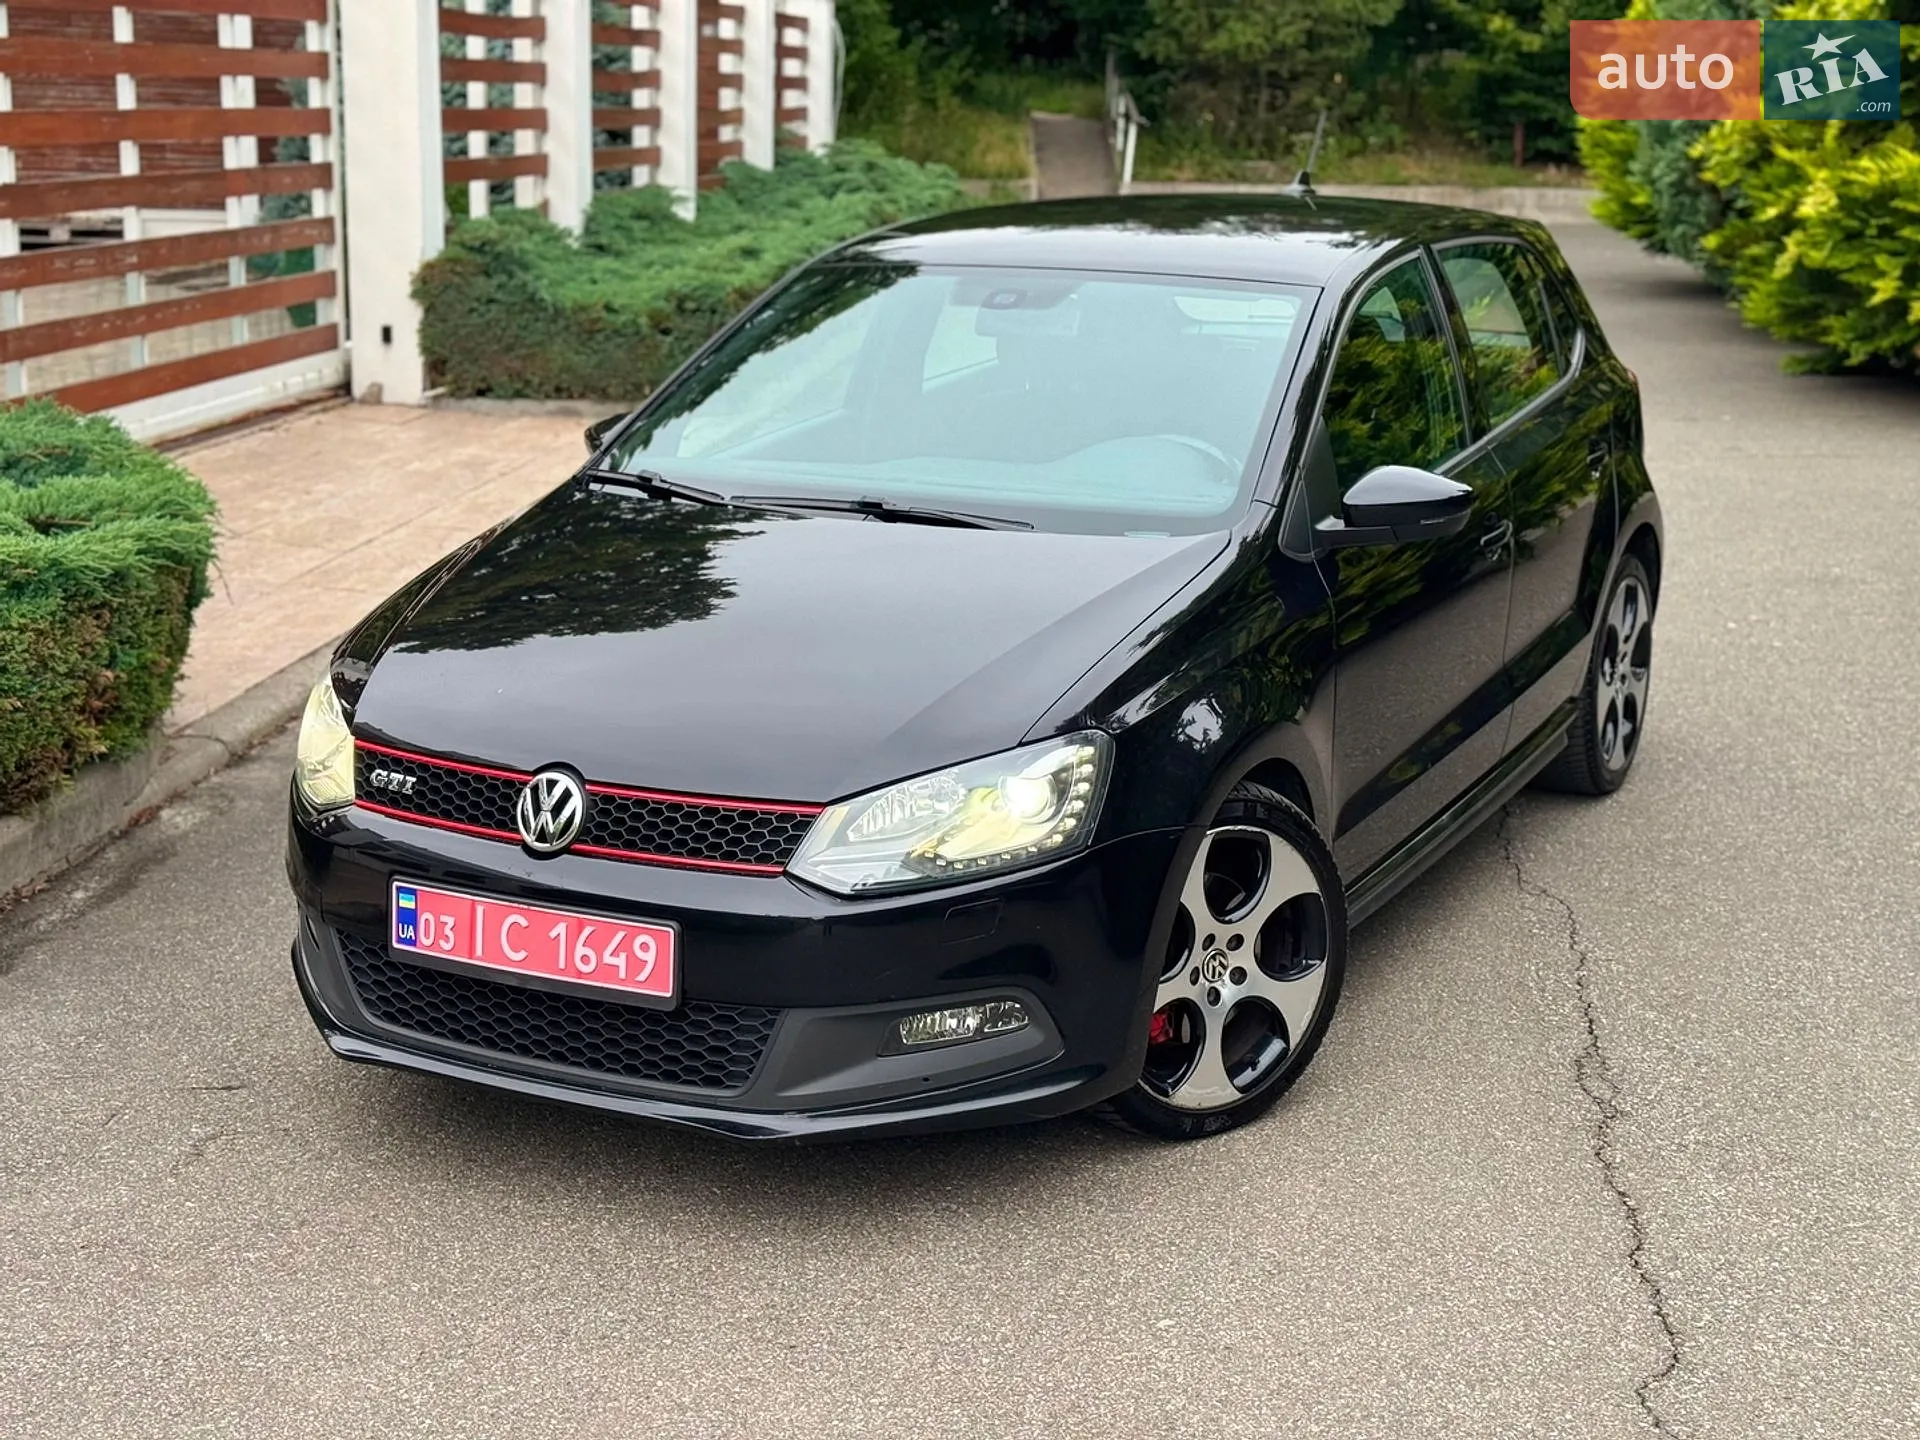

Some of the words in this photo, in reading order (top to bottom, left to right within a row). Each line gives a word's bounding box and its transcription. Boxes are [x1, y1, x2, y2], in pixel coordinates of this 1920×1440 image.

[369, 768, 417, 795] GTI
[398, 923, 416, 940] UA
[420, 911, 456, 951] 03
[548, 921, 658, 983] 1649
